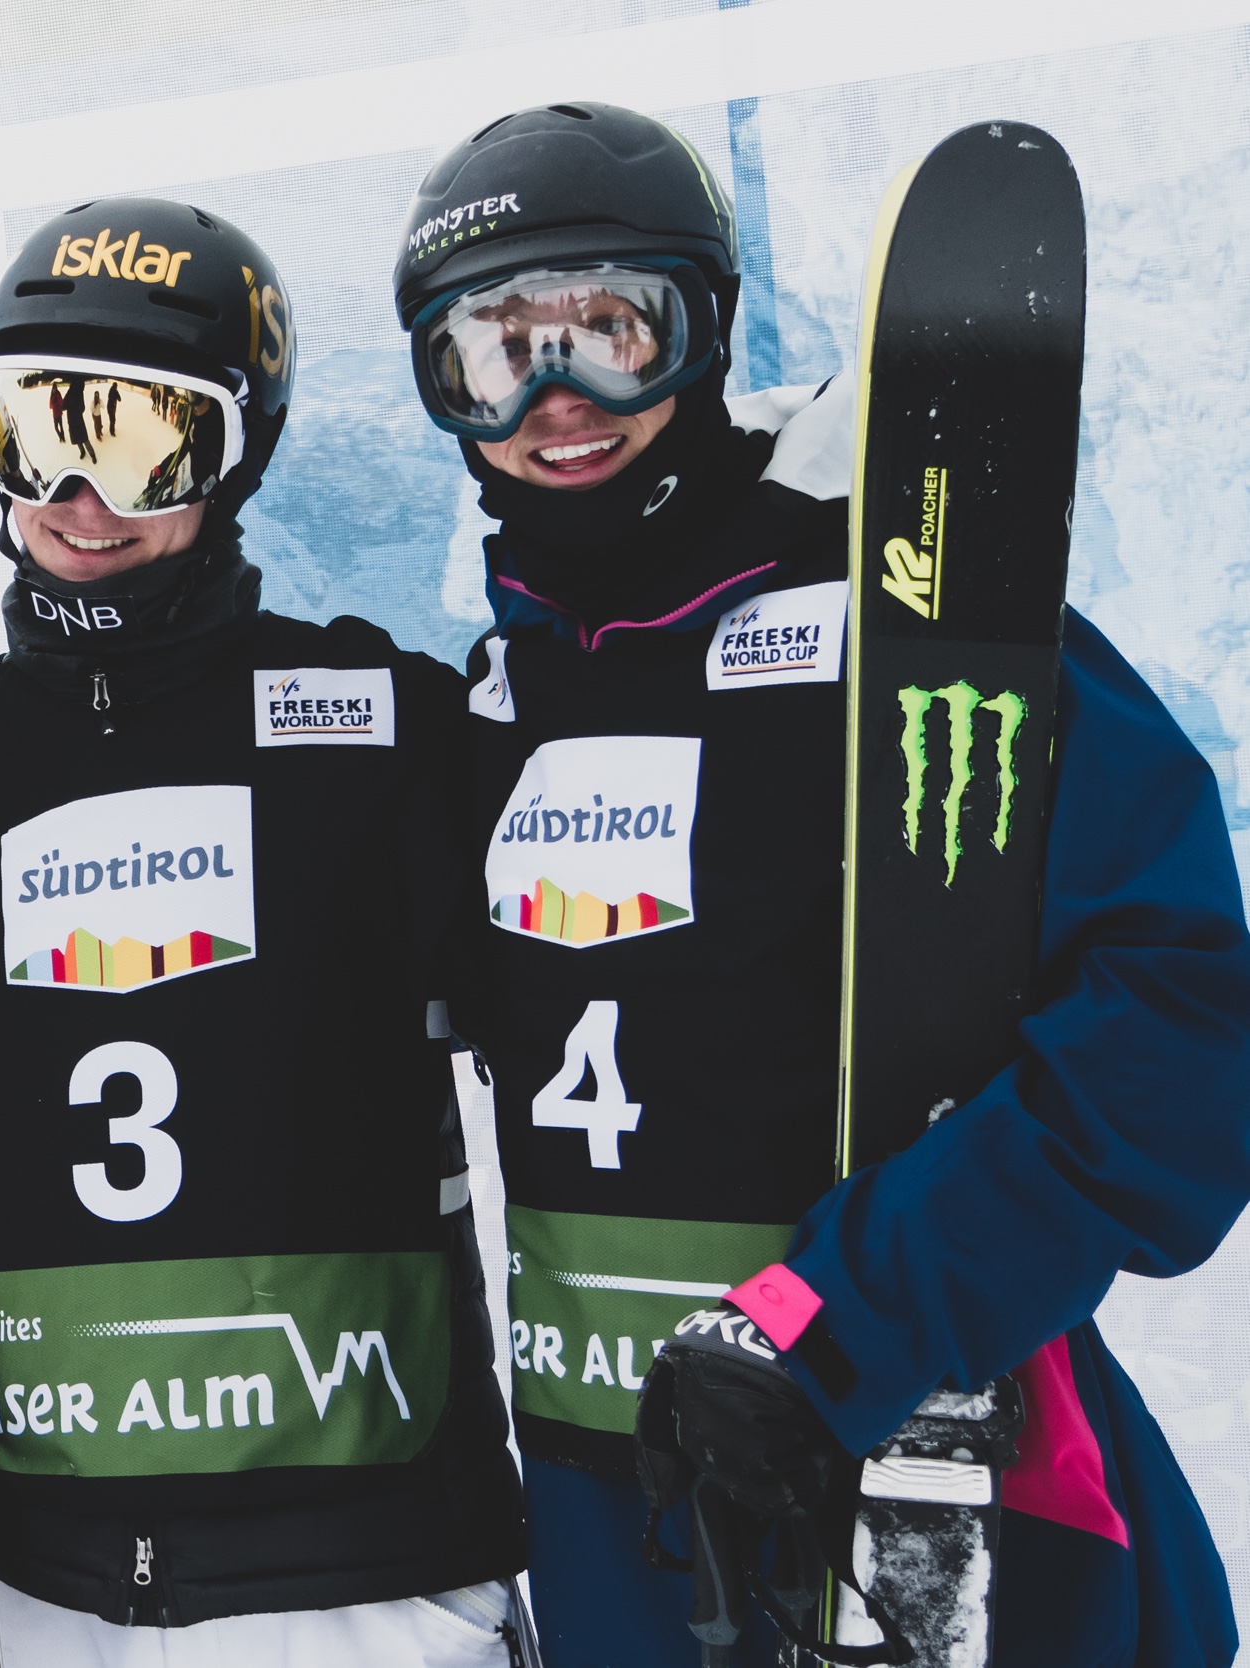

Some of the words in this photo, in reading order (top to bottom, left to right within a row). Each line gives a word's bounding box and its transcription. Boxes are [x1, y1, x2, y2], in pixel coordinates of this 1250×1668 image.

[409, 193, 521, 251] MONSTER
[418, 220, 497, 259] ENERGY
[52, 229, 192, 287] isklar
[882, 537, 933, 618] K2
[921, 466, 939, 546] POACHER
[31, 591, 123, 636] DNB
[721, 648, 781, 667] WORLD
[786, 645, 818, 661] CUP
[722, 624, 820, 651] FREESKI
[270, 698, 372, 715] FREESKI
[270, 715, 334, 729] WORLD
[339, 714, 373, 727] CUP
[532, 1000, 642, 1169] 4
[68, 1040, 183, 1222] 3
